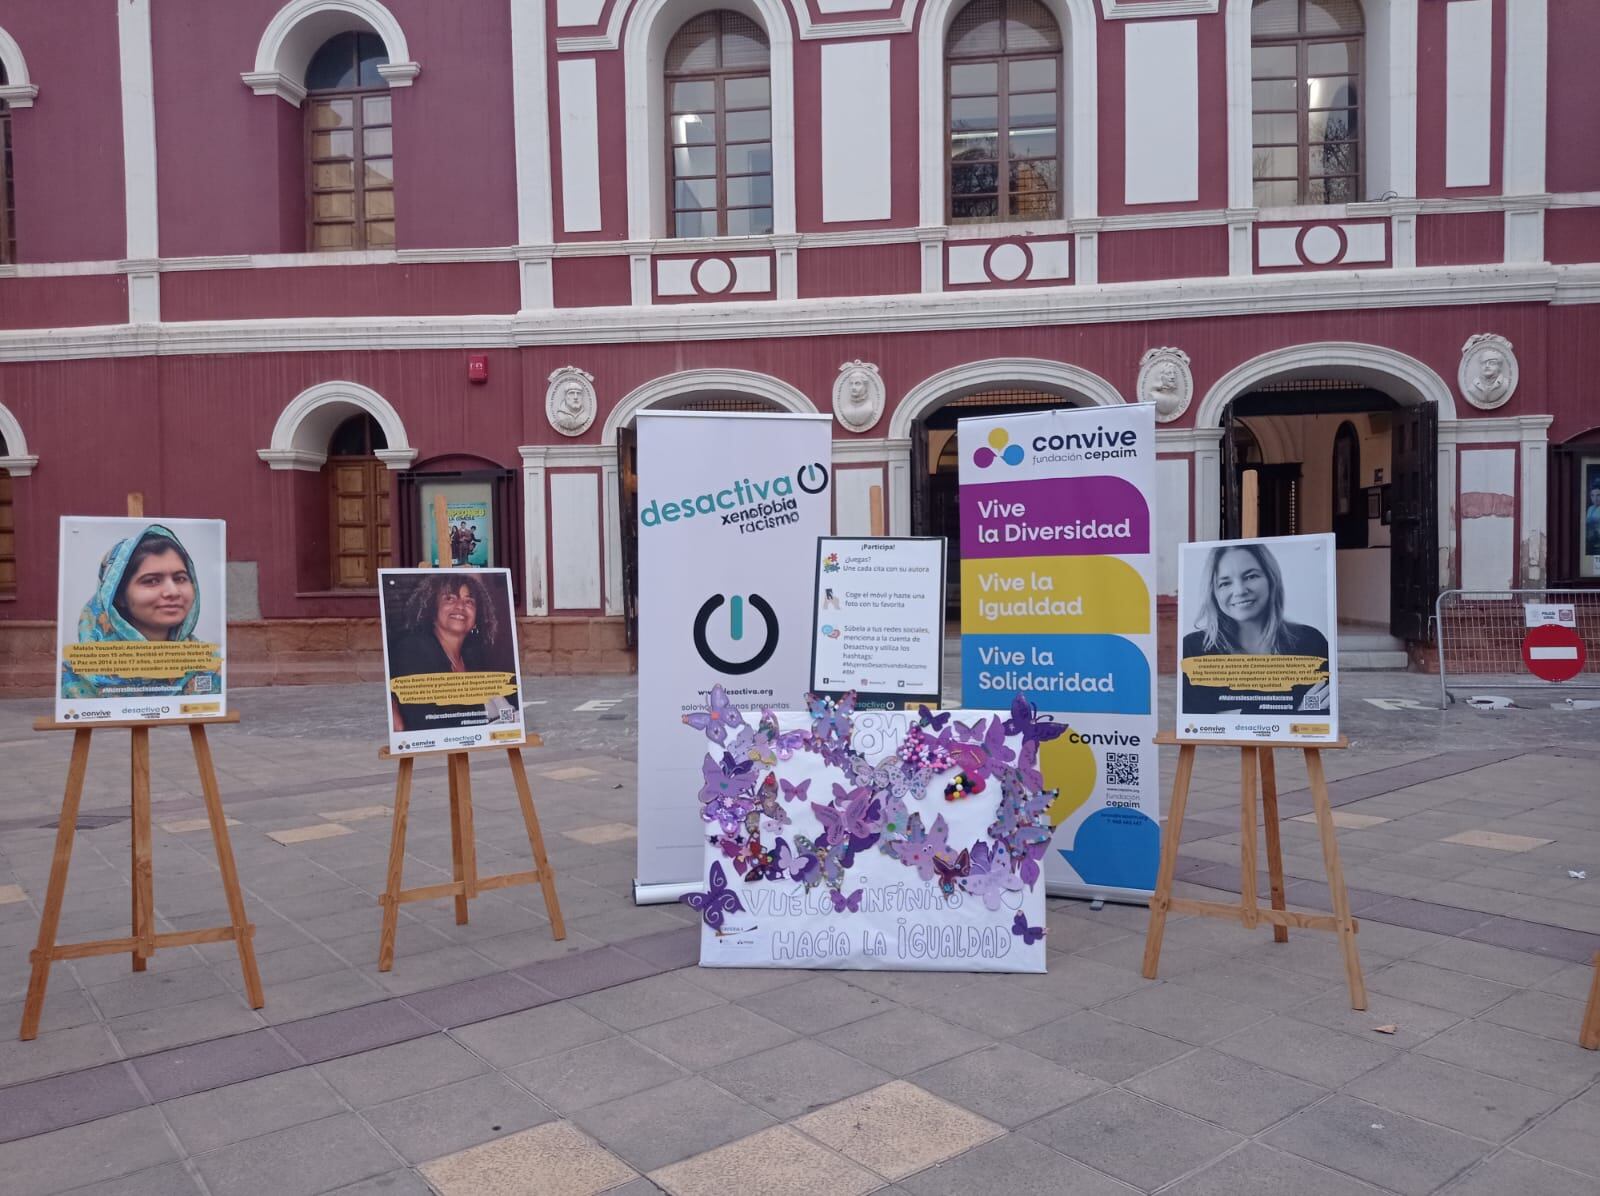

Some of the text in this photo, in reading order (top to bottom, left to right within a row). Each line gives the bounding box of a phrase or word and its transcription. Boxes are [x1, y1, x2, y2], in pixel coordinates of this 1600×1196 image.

[1032, 425, 1137, 452] convive
[1033, 447, 1137, 464] fundación cepaim
[640, 475, 793, 527] desactiva
[978, 500, 1025, 518] Vive
[721, 497, 797, 526] xenofobia
[739, 511, 799, 534] racismo
[978, 518, 1131, 543] la Diversidad
[978, 572, 1053, 592] Vive la
[979, 597, 1083, 620] Igualdad
[979, 647, 1054, 665] Vive la
[978, 672, 1114, 692] Solidaridad
[122, 706, 160, 714] desactiva
[852, 713, 907, 756] 8M
[1069, 730, 1140, 746] convive
[1106, 792, 1140, 801] fundación
[1106, 800, 1140, 808] cepaim
[863, 930, 887, 956] LA
